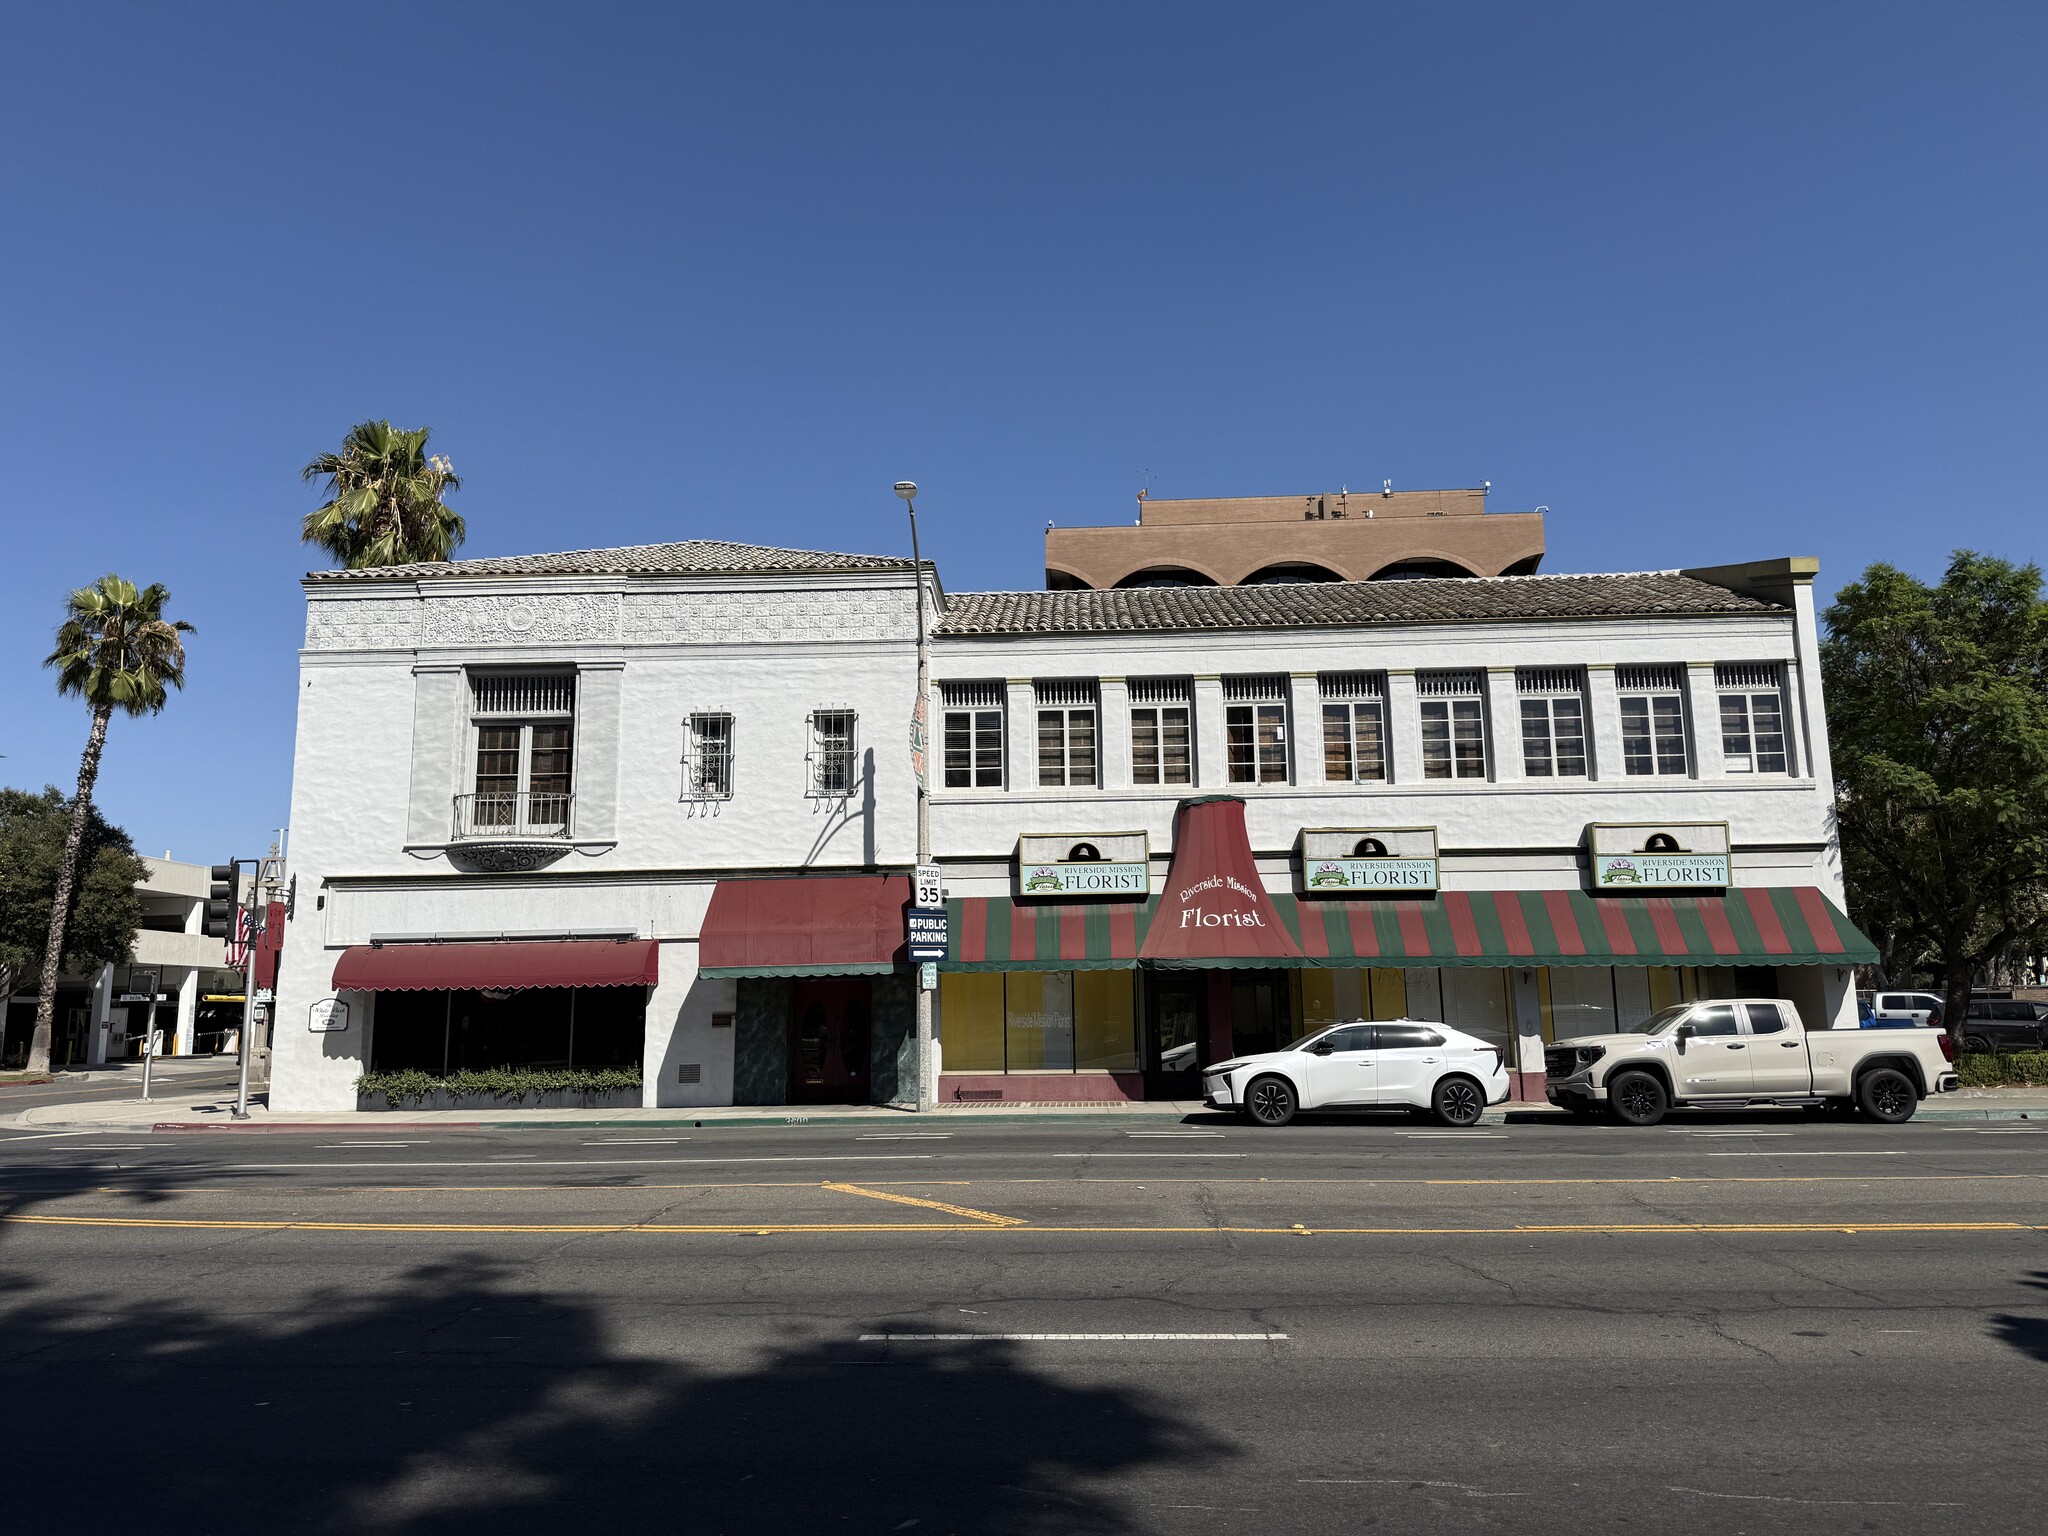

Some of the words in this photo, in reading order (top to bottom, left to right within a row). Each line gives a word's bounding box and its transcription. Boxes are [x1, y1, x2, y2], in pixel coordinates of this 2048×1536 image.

[1350, 862, 1395, 870] RIVERSIDE
[1642, 859, 1687, 867] RIVERSIDE
[918, 869, 940, 877] SPEED
[1064, 866, 1108, 874] RIVERSIDE
[1643, 867, 1725, 882] FLORIST
[920, 878, 937, 886] LIMIT
[1065, 875, 1143, 889] FLORIST
[1351, 870, 1432, 885] FLORIST
[919, 887, 939, 903] 35
[1179, 874, 1224, 903] Riverside
[1226, 875, 1257, 903] Mission
[917, 918, 948, 930] PUBLIC
[1179, 906, 1266, 929] Florist
[910, 931, 948, 943] PARKING
[1008, 1011, 1033, 1028] Riverside
[1034, 1011, 1054, 1028] Mission
[1054, 1011, 1071, 1028] Florist
